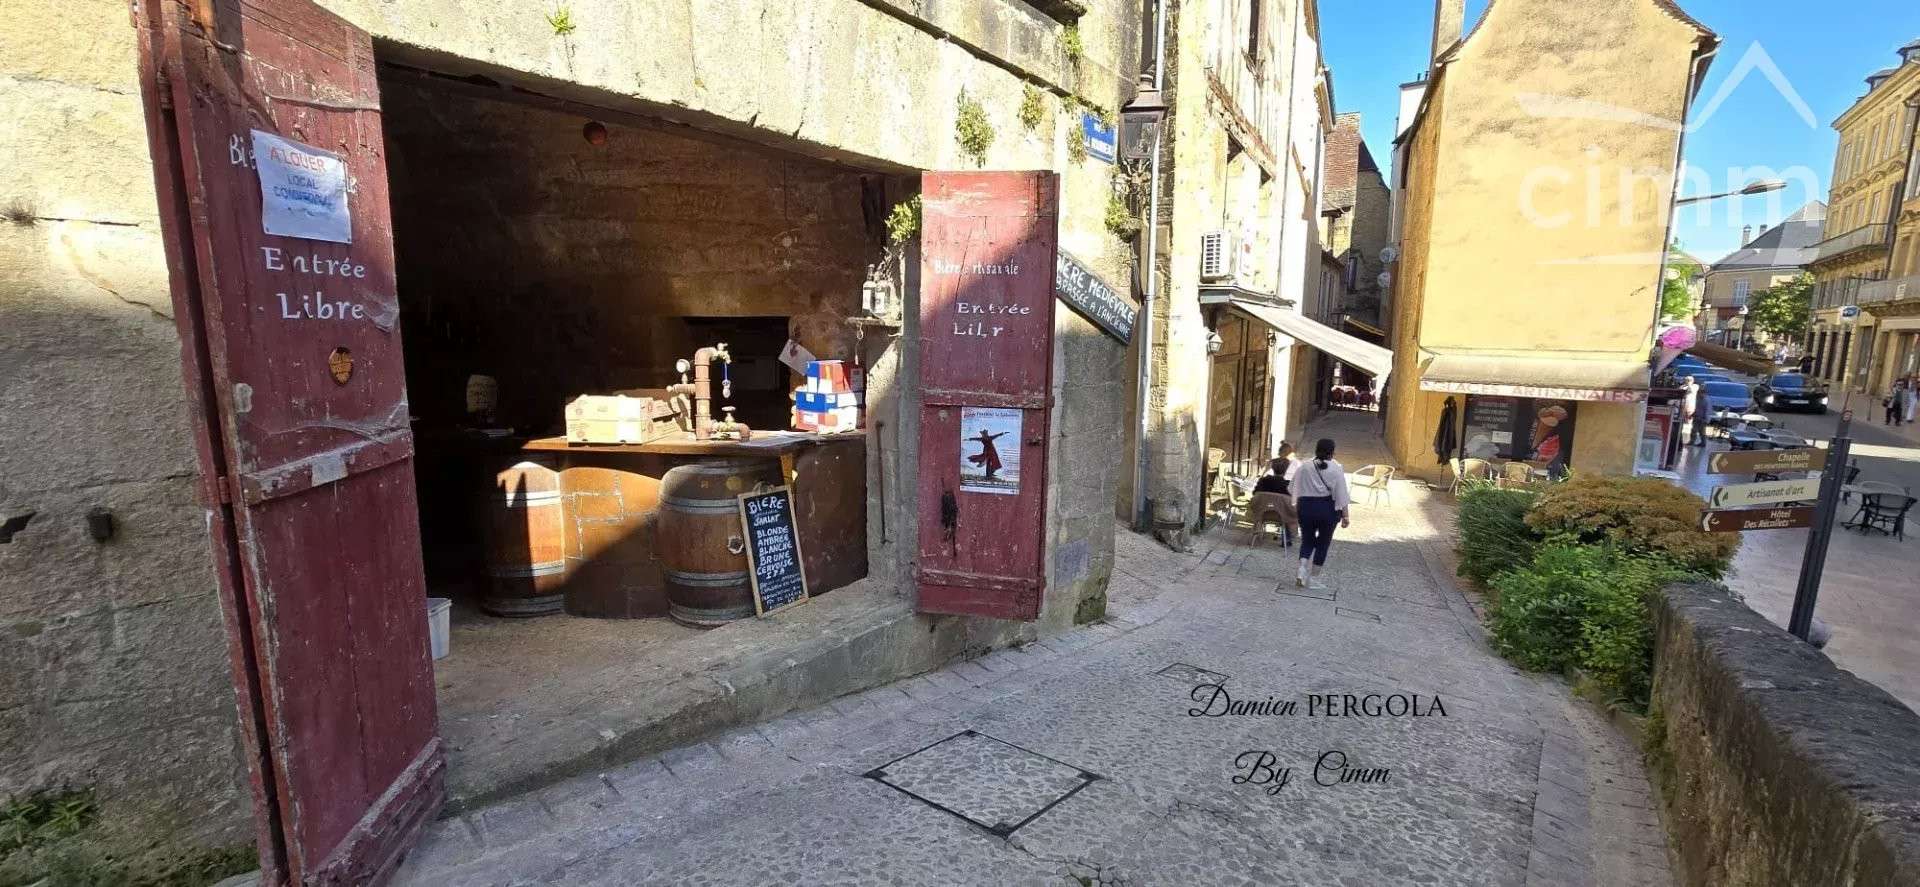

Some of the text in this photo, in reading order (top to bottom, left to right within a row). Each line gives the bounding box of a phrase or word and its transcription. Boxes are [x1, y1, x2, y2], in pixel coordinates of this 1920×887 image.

[270, 146, 328, 173] A LOUER
[287, 174, 319, 190] LOCAL
[260, 246, 366, 278] Entrée
[275, 291, 364, 320] Libre
[956, 302, 1031, 315] Entrée
[1513, 386, 1635, 402] ARTISANALES
[1747, 485, 1804, 498] Artisanat d'art
[756, 525, 789, 539] BLONDE
[758, 541, 793, 558] BLANCHE
[757, 557, 794, 576] CERVOISE
[760, 550, 791, 567] BRUNE
